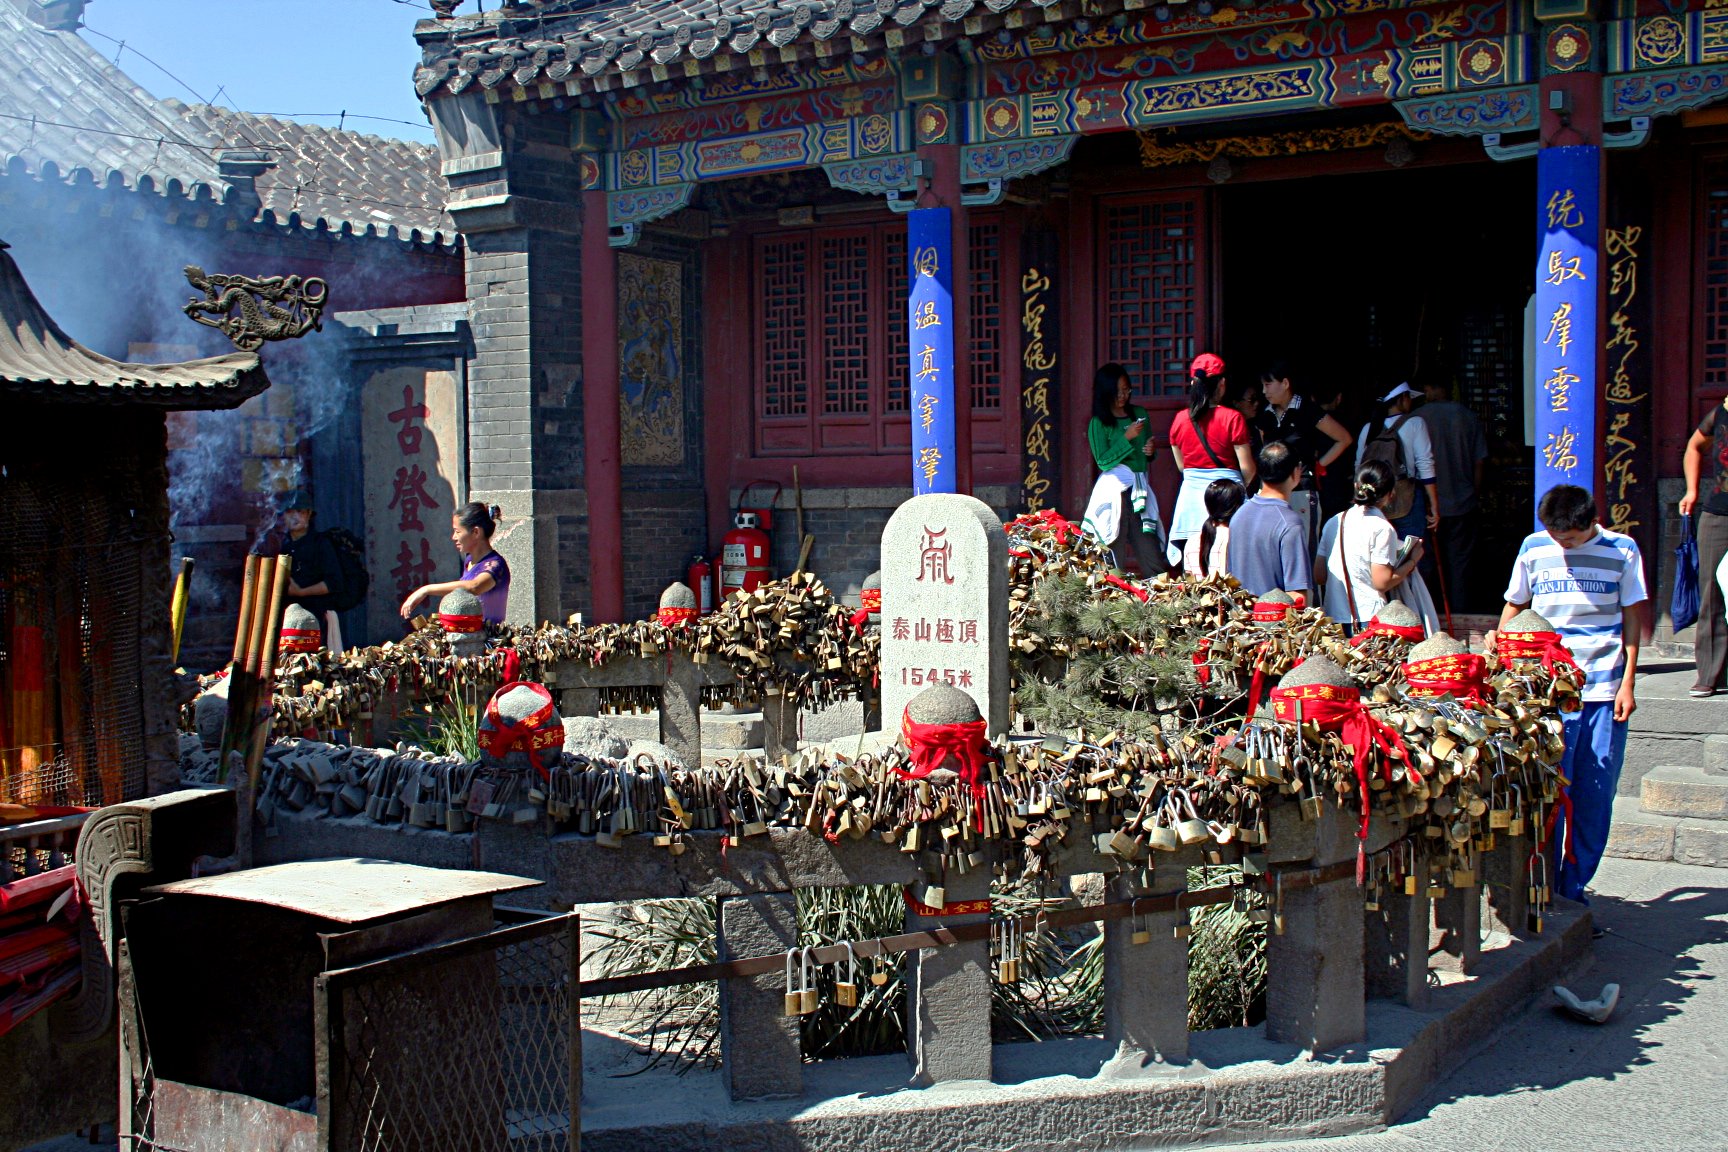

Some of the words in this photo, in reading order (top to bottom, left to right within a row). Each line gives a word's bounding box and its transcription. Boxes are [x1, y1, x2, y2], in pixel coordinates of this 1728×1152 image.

[1566, 581, 1607, 593] FASHION
[892, 616, 980, 645] 泰山極頂
[901, 666, 974, 688] 1545米
